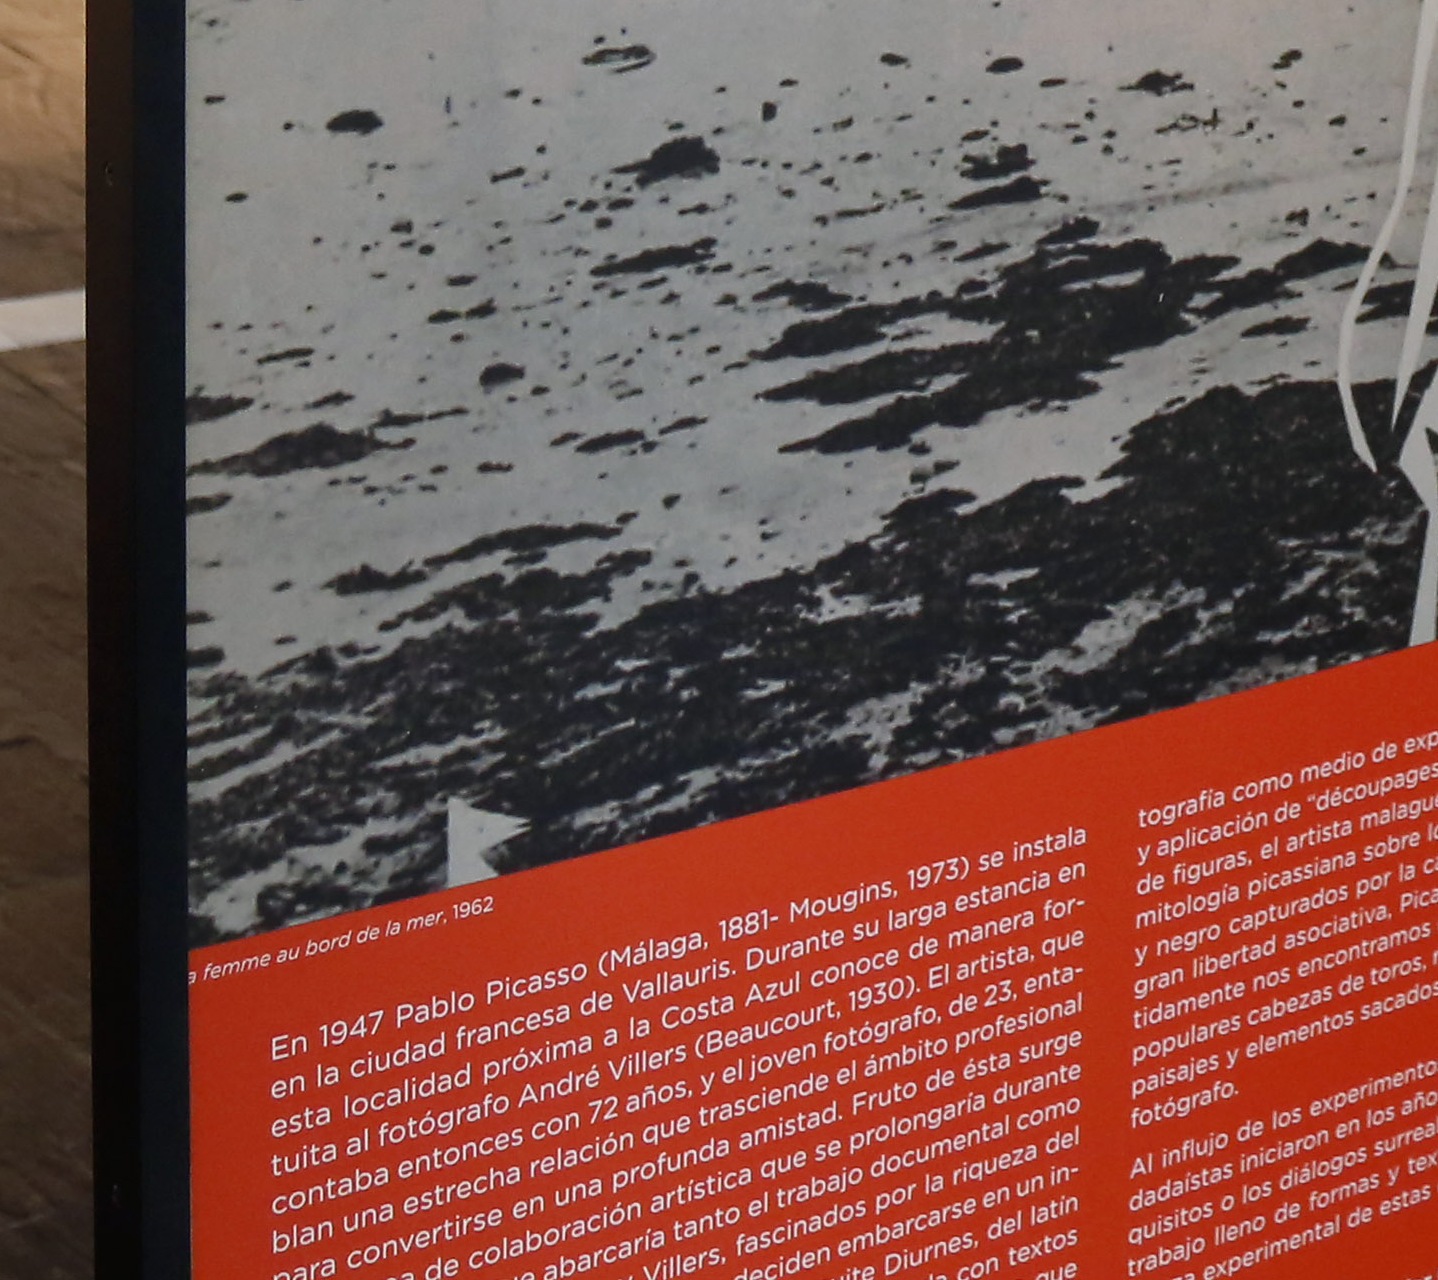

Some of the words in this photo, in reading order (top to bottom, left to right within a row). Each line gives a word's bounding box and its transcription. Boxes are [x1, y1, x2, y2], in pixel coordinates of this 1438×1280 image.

[1137, 787, 1226, 829] tografía
[1231, 771, 1294, 803] como
[1298, 750, 1366, 785] medio
[1370, 740, 1398, 763] de
[202, 953, 272, 981] femme
[275, 945, 301, 964] au
[304, 929, 353, 957] bord
[356, 924, 381, 945] de
[384, 919, 402, 938] la
[406, 910, 448, 933] mer,
[452, 895, 494, 920] 1962
[270, 1033, 308, 1061] En
[318, 1009, 385, 1048] 1947
[396, 989, 476, 1029] Pablo
[486, 963, 588, 1005] Picasso
[598, 931, 709, 978] (Málaga,
[718, 907, 780, 943] 1881-
[789, 880, 898, 923] Mougins,
[906, 855, 970, 891] 1973)
[977, 850, 1005, 873] se
[1012, 825, 1087, 863] instala
[270, 1074, 306, 1099] en
[316, 1063, 340, 1089] la
[349, 1031, 446, 1079] ciudad
[454, 1003, 571, 1051] francesa
[579, 989, 614, 1017] de
[621, 957, 737, 1004] Vallauris.
[745, 928, 846, 971] Durante
[852, 918, 880, 941] su
[887, 900, 948, 932] larga
[954, 869, 1052, 913] estancia
[1057, 861, 1086, 884] en
[270, 1106, 332, 1139] esta
[344, 1061, 472, 1119] localidad
[482, 1035, 593, 1087] próxima
[602, 1027, 618, 1047] a
[628, 1015, 651, 1041] la
[660, 995, 735, 1030] Costa
[744, 969, 800, 1008] Azul
[810, 948, 900, 989] conoce
[908, 935, 940, 961] de
[948, 909, 1035, 950] manera
[1042, 897, 1086, 922] for-
[270, 1143, 338, 1177] tuita
[345, 1127, 370, 1157] al
[377, 1092, 510, 1147] fotógrafo
[516, 1063, 600, 1109] André
[606, 1043, 688, 1081] Villers
[694, 997, 842, 1059] (Beaucourt,
[847, 974, 922, 1013] 1930).
[927, 962, 950, 990] El
[955, 945, 1036, 981] artista,
[1040, 929, 1085, 958] que
[271, 1166, 390, 1215] contaba
[396, 1127, 524, 1179] entonces
[530, 1111, 580, 1141] con
[587, 1095, 619, 1125] 72
[624, 1079, 694, 1113] años,
[700, 1071, 716, 1097] y
[721, 1057, 744, 1085] el
[748, 1041, 817, 1083] joven
[822, 1004, 942, 1055] fotógrafo,
[947, 992, 979, 1017] de
[982, 979, 1018, 1008] 23,
[1022, 965, 1084, 995] enta-
[272, 1219, 334, 1255] blan
[342, 1203, 394, 1233] una
[402, 1165, 522, 1215] estrecha
[529, 1131, 634, 1179] relación
[642, 1115, 692, 1146] que
[698, 1071, 830, 1127] trasciende
[836, 1059, 857, 1086] el
[862, 1037, 949, 1078] ámbito
[954, 991, 1083, 1055] profesional
[1128, 1151, 1154, 1180] Al
[1161, 1131, 1230, 1169] influjo
[1236, 1119, 1265, 1143] de
[1271, 1107, 1302, 1131] los
[1130, 1079, 1240, 1129] fotógrafo.
[346, 1207, 504, 1269] convertirse
[512, 1195, 545, 1219] en
[554, 1177, 603, 1207] una
[612, 1136, 730, 1195] profunda
[738, 1099, 844, 1151] amistad.
[852, 1081, 918, 1117] Fruto
[924, 1067, 956, 1093] de
[962, 1051, 1012, 1081] ésta
[1018, 1029, 1083, 1064] surge
[424, 1255, 460, 1280] de
[468, 1201, 642, 1270] colaboración
[650, 1167, 752, 1214] artística
[760, 1149, 808, 1181] que
[814, 1139, 842, 1163] se
[848, 1091, 986, 1155] prolongaría
[992, 1063, 1082, 1105] durante
[542, 1227, 666, 1280] abarcaría
[672, 1205, 742, 1242] tanto
[746, 1190, 770, 1218] el
[775, 1165, 864, 1209] trabajo
[868, 1113, 1010, 1179] documental
[1016, 1097, 1082, 1131] como
[642, 1247, 727, 1280] Villers,
[735, 1199, 867, 1257] fascinados
[874, 1183, 918, 1216] por
[924, 1173, 944, 1195] la
[952, 1143, 1038, 1186] riqueza
[1044, 1123, 1080, 1155] del
[836, 1197, 978, 1258] embarcarse
[981, 1185, 1011, 1209] en
[1015, 1175, 1045, 1198] un
[1049, 1165, 1080, 1187] in-
[884, 1231, 980, 1277] Diurnes,
[986, 1209, 1022, 1241] del
[1030, 1194, 1079, 1227] latín
[1006, 1228, 1078, 1267] textos
